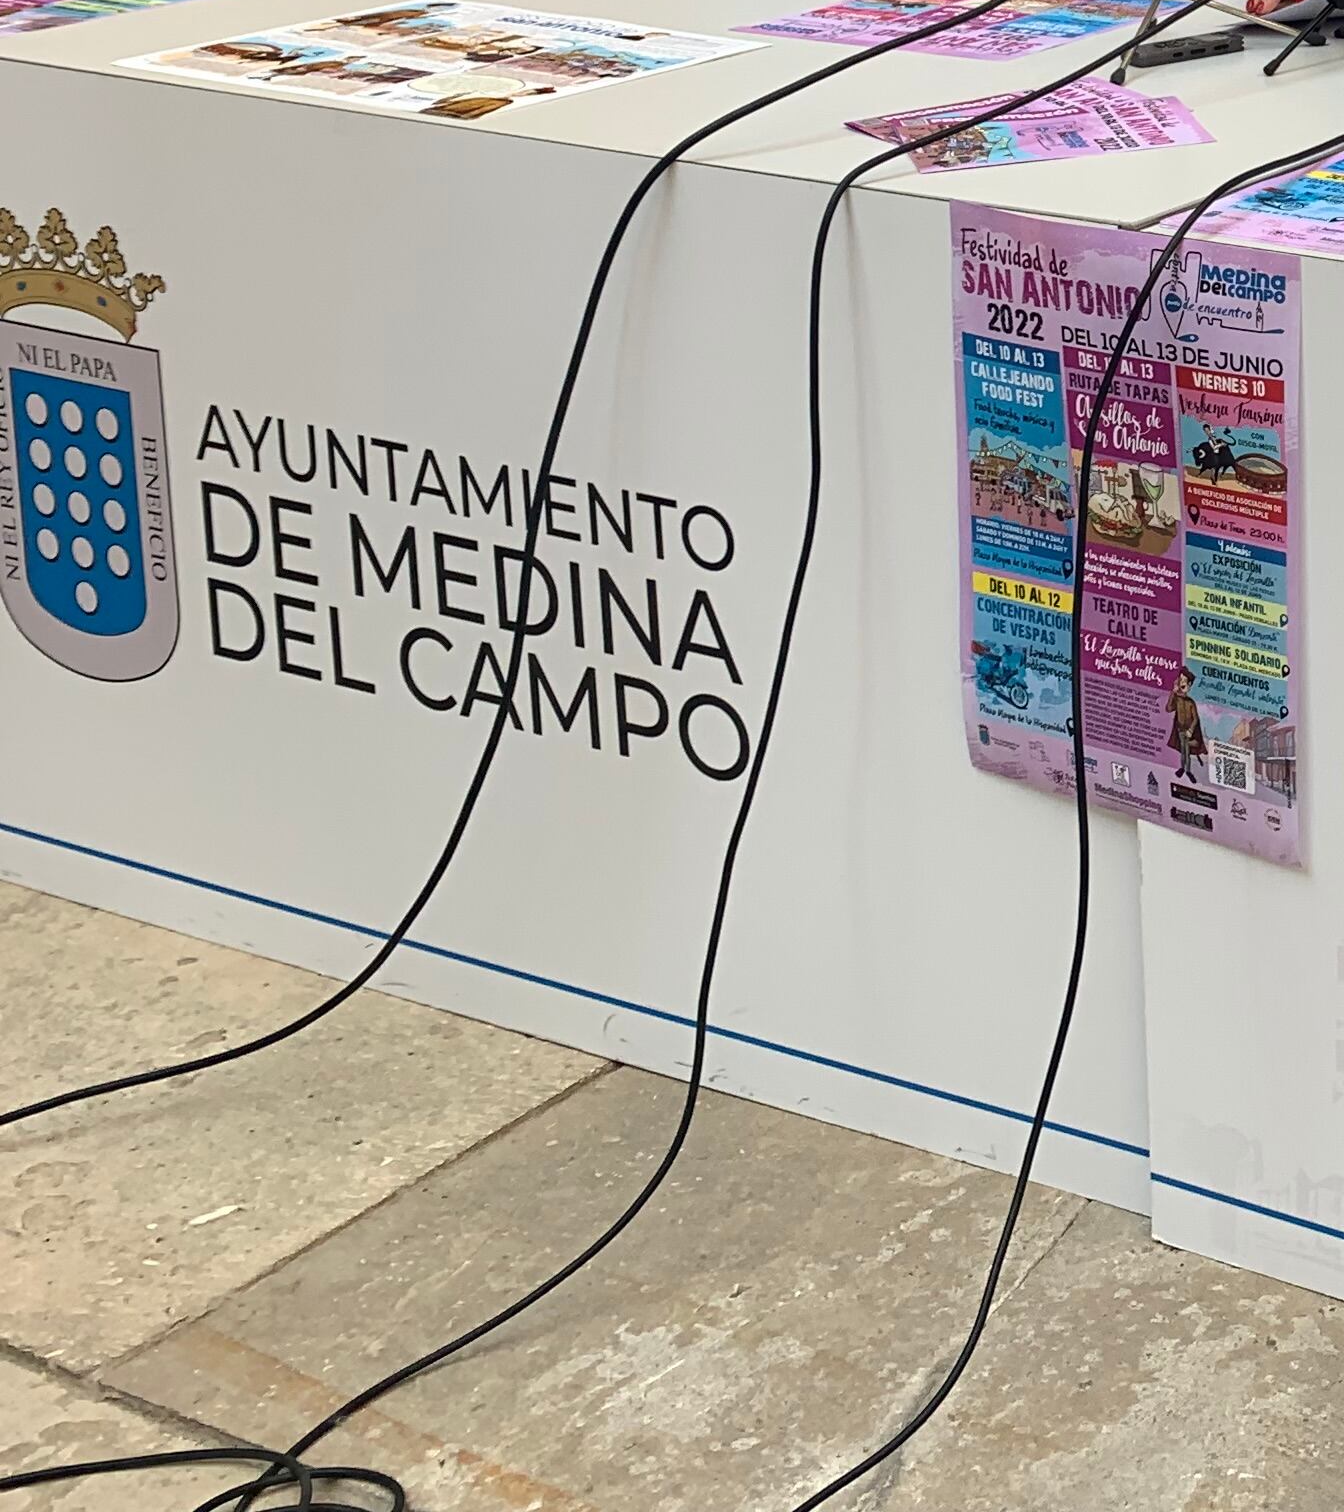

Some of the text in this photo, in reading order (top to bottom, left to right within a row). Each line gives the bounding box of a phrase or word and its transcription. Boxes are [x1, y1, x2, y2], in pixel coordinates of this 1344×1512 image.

[960, 228, 1067, 276] Festividad de
[961, 260, 1012, 302] SAN
[987, 303, 1044, 341] 2022
[17, 343, 117, 382] NI EL PAPA
[971, 361, 1054, 392] CALLEJEANDO
[982, 381, 1043, 408] FOOD FEST
[142, 438, 167, 582] BENEFICIO
[195, 405, 735, 574] AYUNTAMIENTO
[201, 481, 744, 685] DE MEDINA
[206, 577, 751, 783] DEL CAMPO
